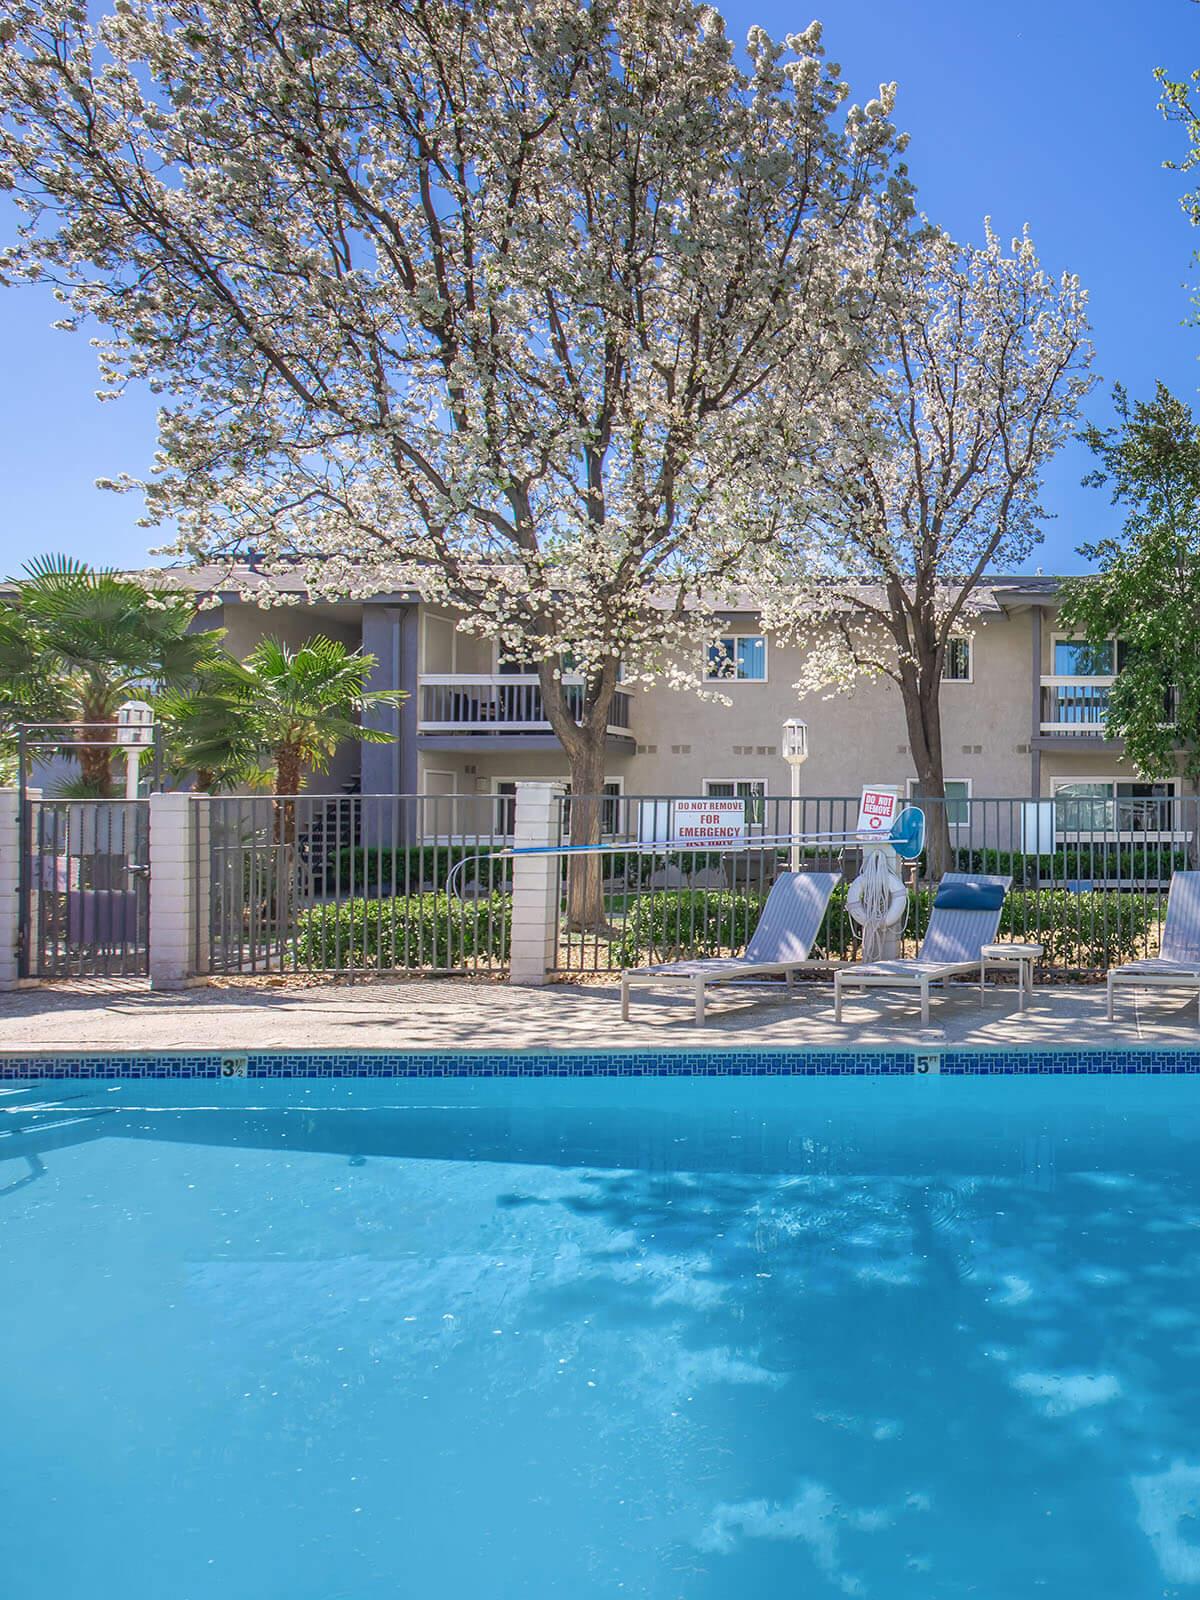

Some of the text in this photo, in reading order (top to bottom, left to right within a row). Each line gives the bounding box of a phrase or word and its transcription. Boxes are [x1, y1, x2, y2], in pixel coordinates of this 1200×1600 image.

[866, 795, 892, 806] DO NOT
[678, 802, 743, 810] DO NOT REMOVE
[864, 803, 891, 815] REMOVE
[700, 815, 720, 824] FOR
[679, 827, 741, 837] EMERGENCY
[917, 1056, 929, 1074] 5
